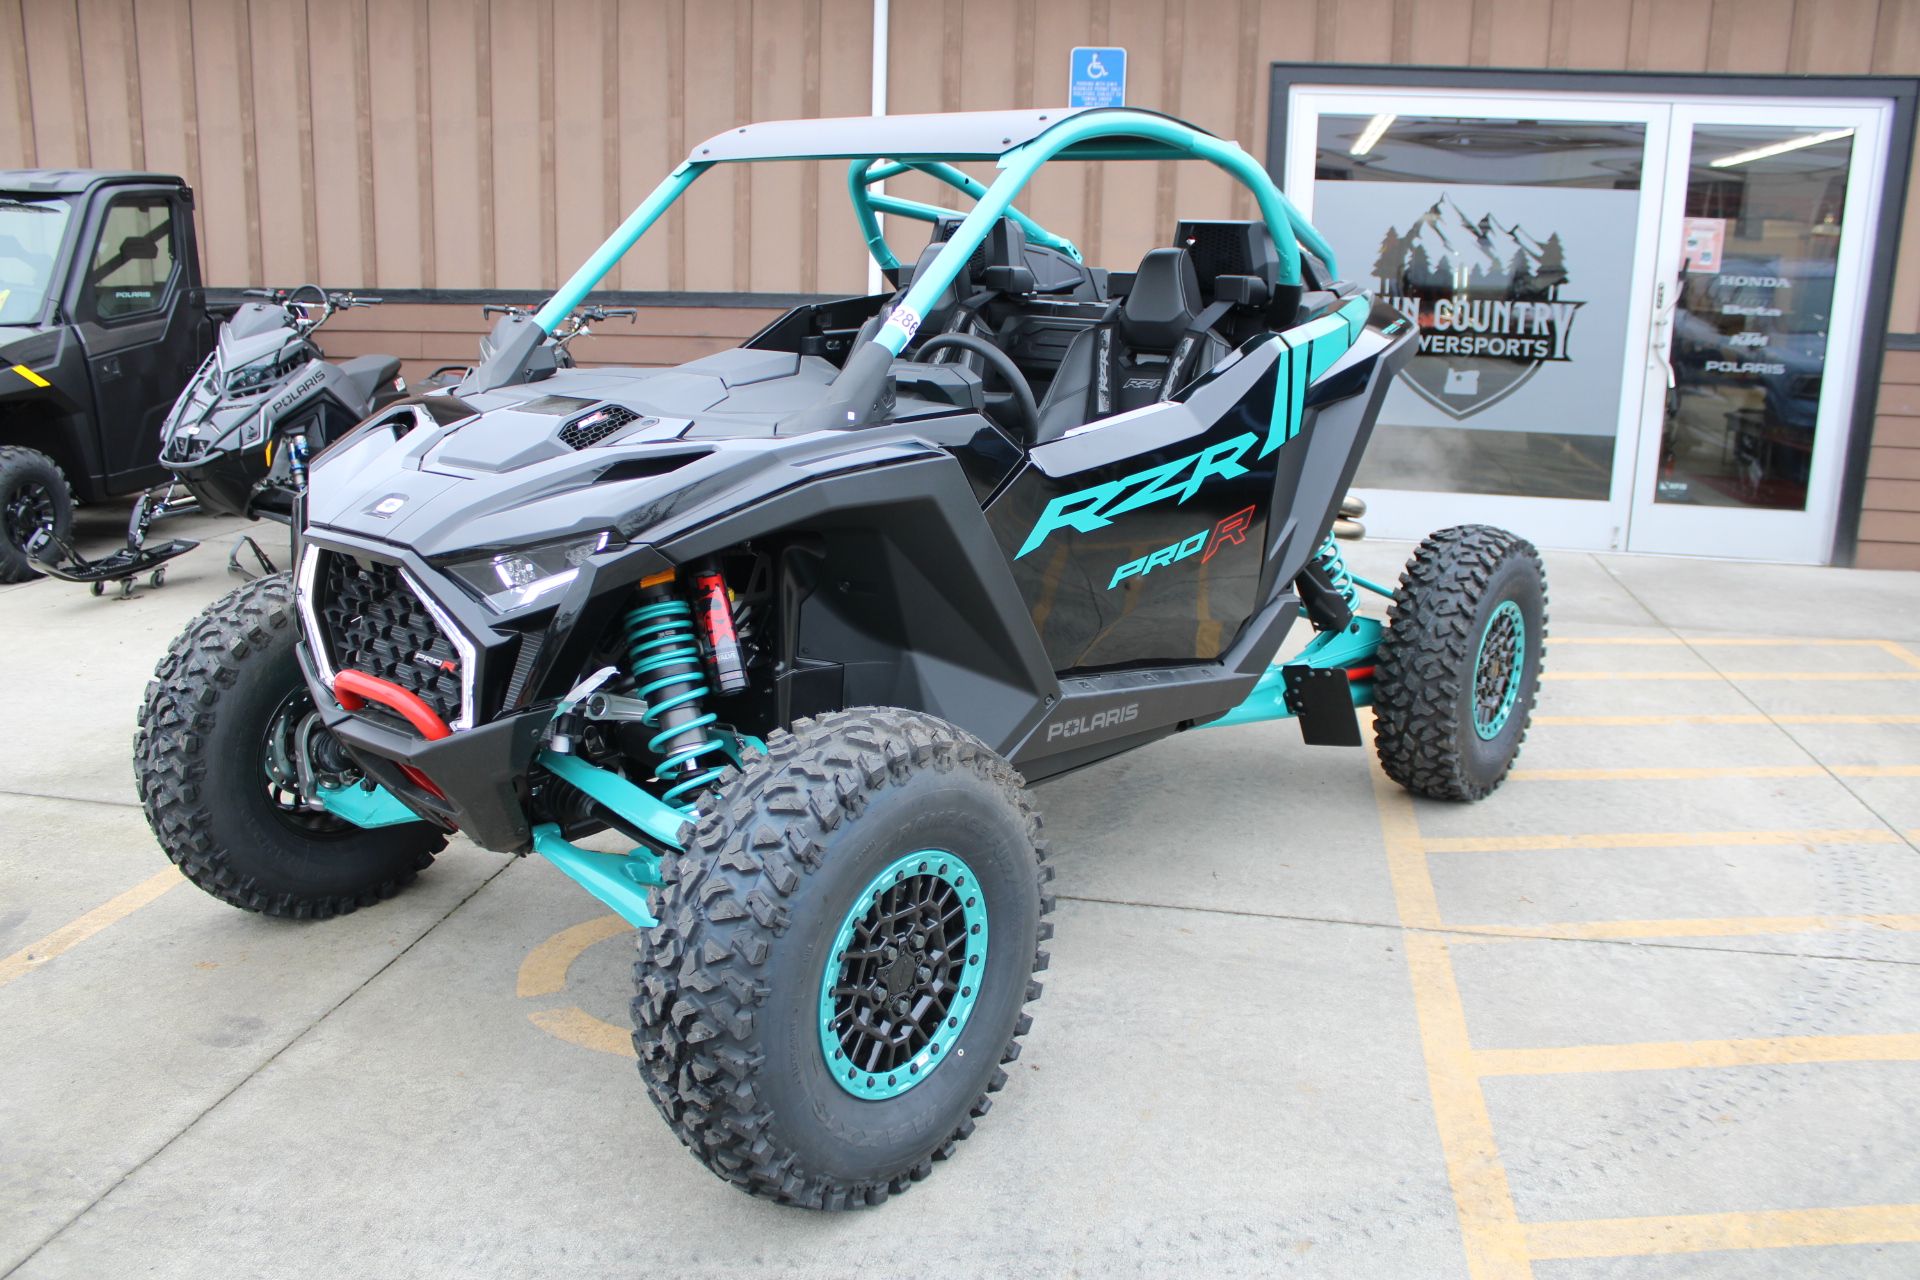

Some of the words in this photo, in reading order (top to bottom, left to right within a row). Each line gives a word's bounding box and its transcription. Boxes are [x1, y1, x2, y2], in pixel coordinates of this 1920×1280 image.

[1720, 275, 1792, 288] HONDA
[1419, 335, 1549, 358] ERSPORTS
[1434, 298, 1577, 359] COUNTRY
[1730, 332, 1769, 347] KTM
[1705, 361, 1787, 375] POLARIS
[272, 370, 326, 414] POLARIS
[1013, 431, 1259, 561] RZR
[1107, 529, 1209, 590] PRO
[1201, 504, 1256, 564] R
[1047, 703, 1139, 742] POLARIS
